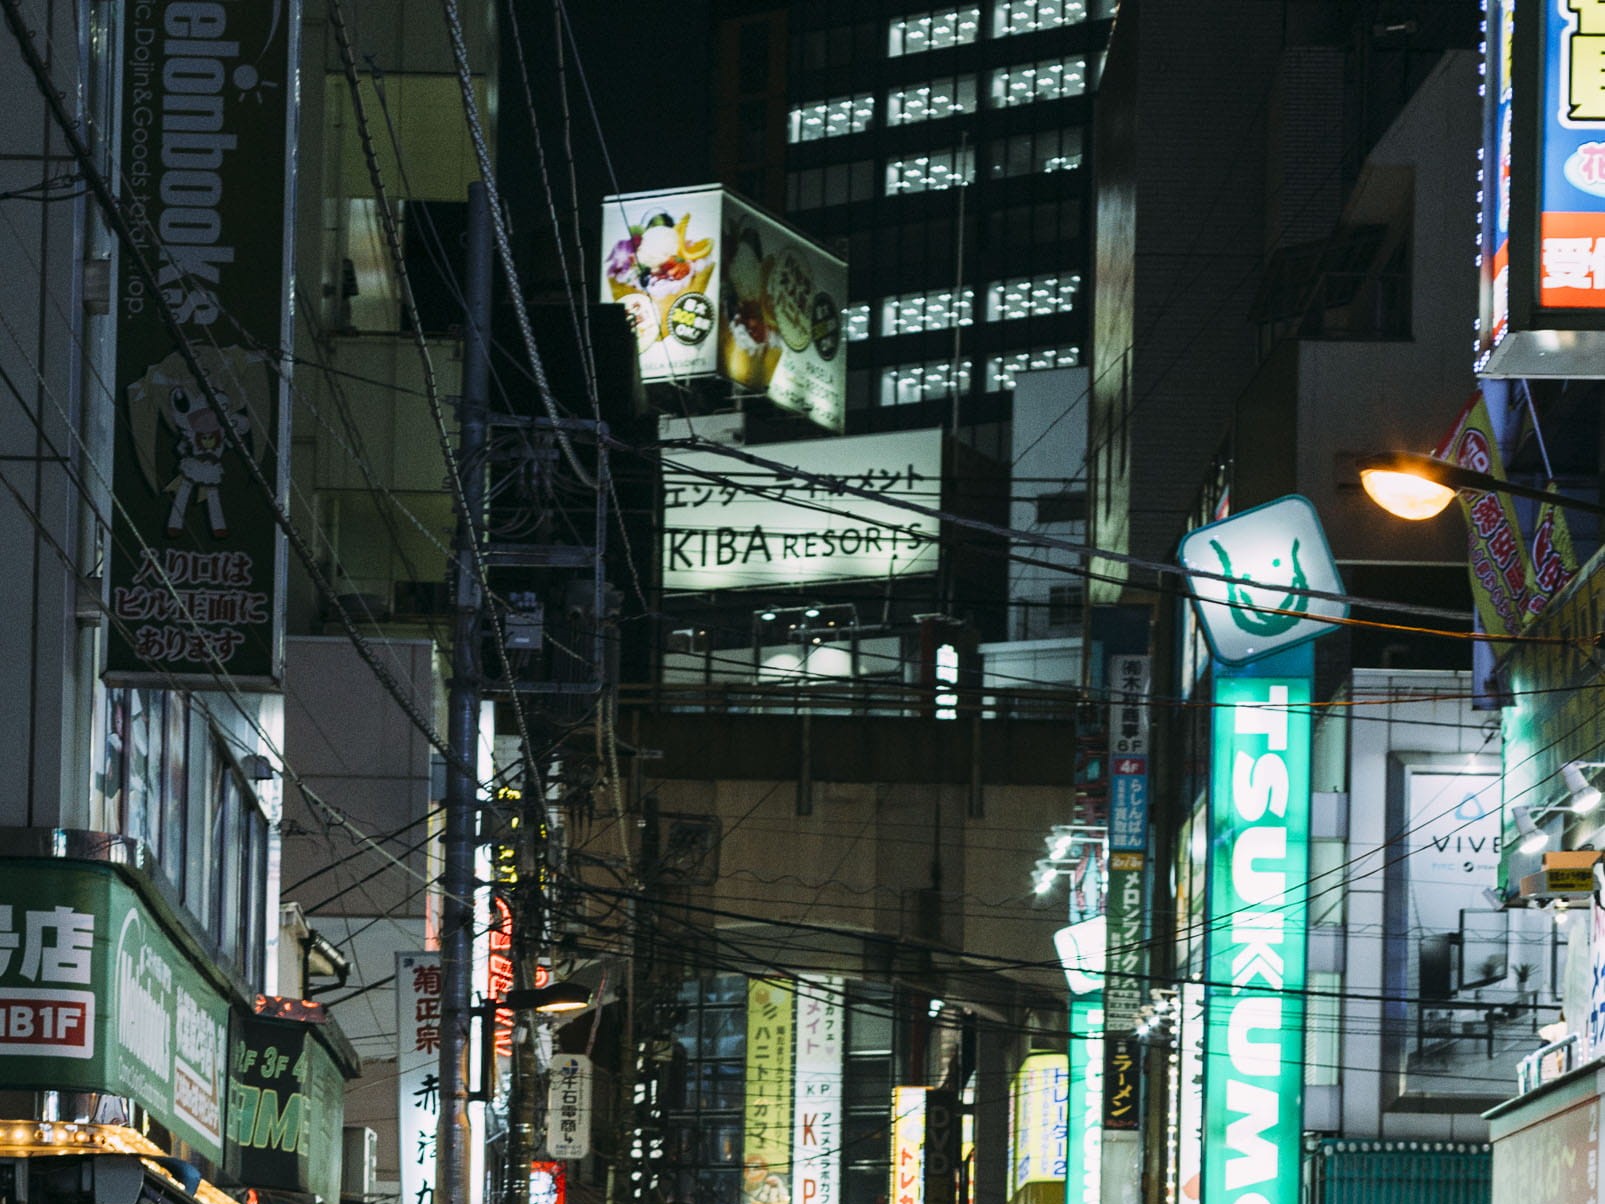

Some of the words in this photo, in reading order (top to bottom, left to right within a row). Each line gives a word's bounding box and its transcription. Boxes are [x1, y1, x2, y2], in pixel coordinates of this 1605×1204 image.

[1542, 237, 1605, 290] 受
[132, 548, 253, 586] 入り口は
[669, 525, 772, 571] KIBA
[783, 522, 922, 559] RESORTS
[115, 586, 268, 625] ビル正面に
[135, 624, 245, 662] あります
[1117, 740, 1143, 752] 6F
[0, 904, 95, 985] 店
[1122, 871, 1141, 988] メロンブックス
[0, 1005, 82, 1039] B1F
[412, 964, 441, 1054] 菊正宗
[806, 984, 821, 1055] メイト
[261, 1046, 290, 1079] 3F
[1110, 1055, 1134, 1118] ラーメン
